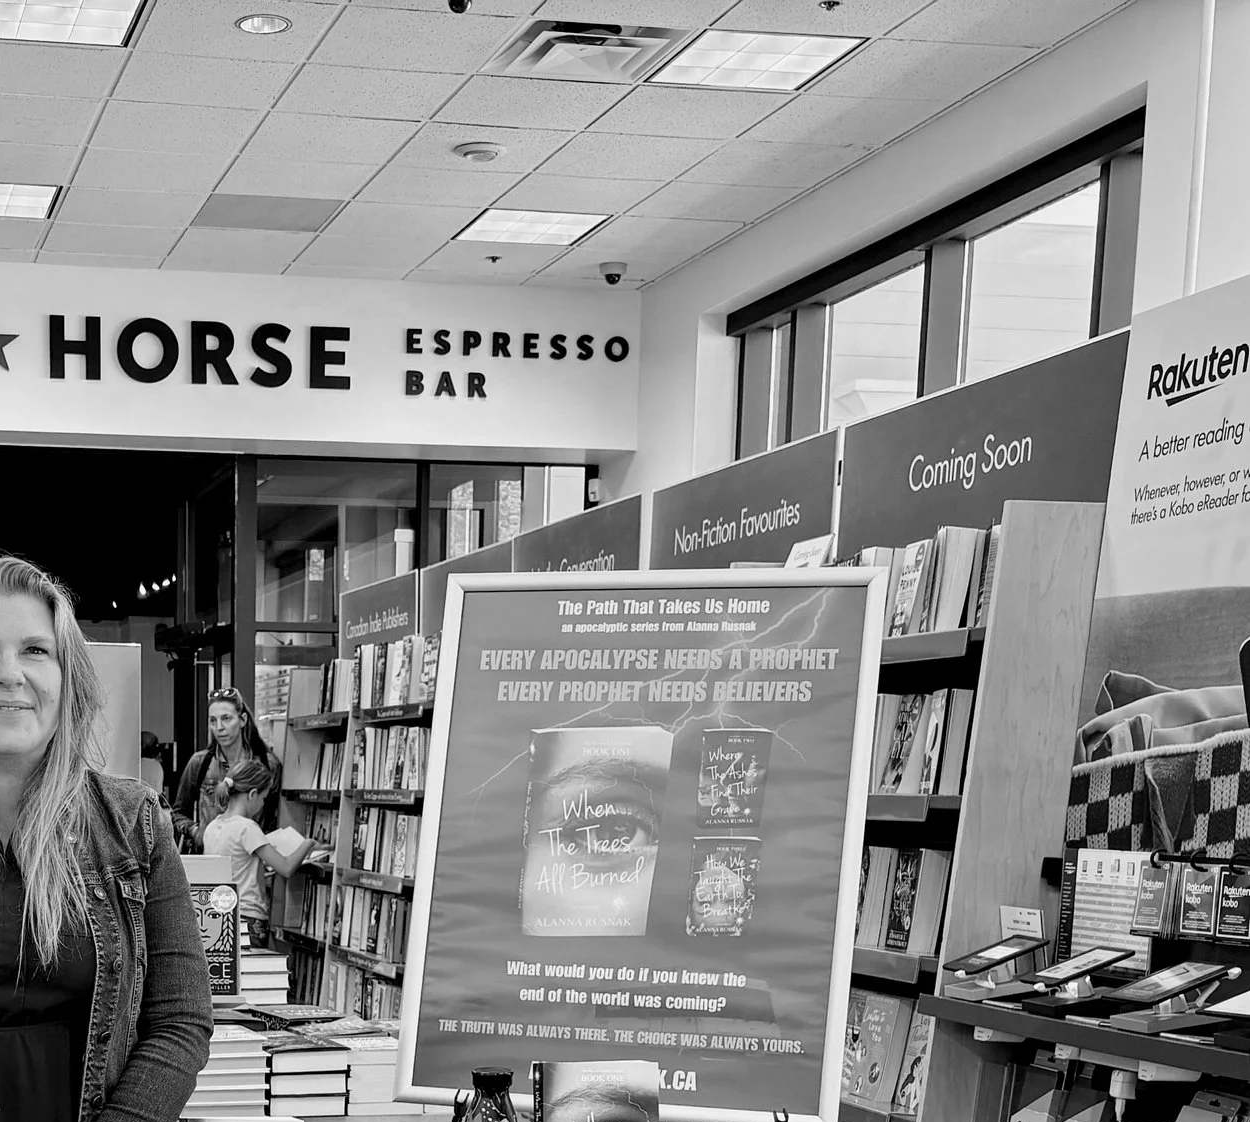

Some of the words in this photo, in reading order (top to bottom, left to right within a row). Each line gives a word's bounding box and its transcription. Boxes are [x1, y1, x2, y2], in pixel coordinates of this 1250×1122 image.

[48, 315, 351, 390] HORSE
[404, 326, 630, 363] ESPRESSO
[403, 368, 488, 399] BAR
[1147, 343, 1250, 400] Rakuten
[1139, 440, 1149, 462] A
[1153, 434, 1190, 458] better
[1193, 417, 1245, 449] reading
[909, 448, 976, 496] Coming
[981, 432, 1033, 475] Soon
[1134, 482, 1181, 502] Whenever,
[1183, 473, 1225, 494] however,
[1229, 470, 1240, 483] or
[1130, 502, 1157, 525] there's
[1159, 506, 1167, 519] a
[1169, 497, 1194, 517] Kobo
[1197, 490, 1238, 512] eReader
[673, 519, 737, 557] Non-Fiction
[739, 500, 801, 543] Favourites
[346, 616, 369, 639] Canadian
[369, 612, 382, 632] Indie
[382, 606, 409, 631] Publishers
[558, 600, 583, 615] The
[586, 600, 618, 615] Path
[623, 599, 654, 614] That
[658, 599, 701, 614] Takes
[704, 599, 724, 614] Us
[728, 598, 770, 614] Home
[561, 623, 573, 633] an
[575, 622, 628, 633] apocalyptic
[630, 621, 660, 632] series
[662, 621, 685, 632] from
[686, 621, 719, 632] Alanna
[721, 620, 757, 632] Rusnak
[479, 649, 536, 671] EVERY
[540, 649, 659, 670] APOCALYPSE
[663, 648, 723, 670] NEEDS
[728, 648, 743, 670] A
[750, 648, 840, 670] PROPHET
[497, 681, 554, 702] EVERY
[558, 681, 644, 702] PROPHET
[648, 680, 707, 702] NEEDS
[712, 680, 813, 702] BELIEVERS
[562, 788, 616, 820] When
[538, 826, 579, 857] The
[575, 824, 631, 854] Trees
[535, 862, 566, 895] All
[570, 856, 645, 890] Burned
[1186, 883, 1213, 893] Rakuten
[1185, 894, 1201, 904] kobo
[506, 960, 541, 976] What
[544, 963, 585, 979] would
[588, 966, 614, 981] you
[617, 966, 635, 982] do
[638, 967, 649, 982] if
[652, 970, 678, 984] you
[681, 970, 719, 986] knew
[722, 972, 747, 988] the
[519, 987, 545, 1002] end
[547, 988, 562, 1003] of
[565, 989, 588, 1004] the
[591, 991, 630, 1006] world
[633, 994, 662, 1009] was
[665, 996, 727, 1012] coming?
[438, 1019, 458, 1032] THE
[460, 1020, 495, 1034] TRUTH
[497, 1022, 524, 1037] WAS
[525, 1025, 571, 1039] ALWAYS
[574, 1027, 610, 1042] THERE.
[613, 1029, 634, 1043] THE
[637, 1031, 678, 1046] CHOICE
[680, 1033, 707, 1048] WAS
[710, 1036, 759, 1051] ALWAYS
[762, 1038, 805, 1054] YOURS.
